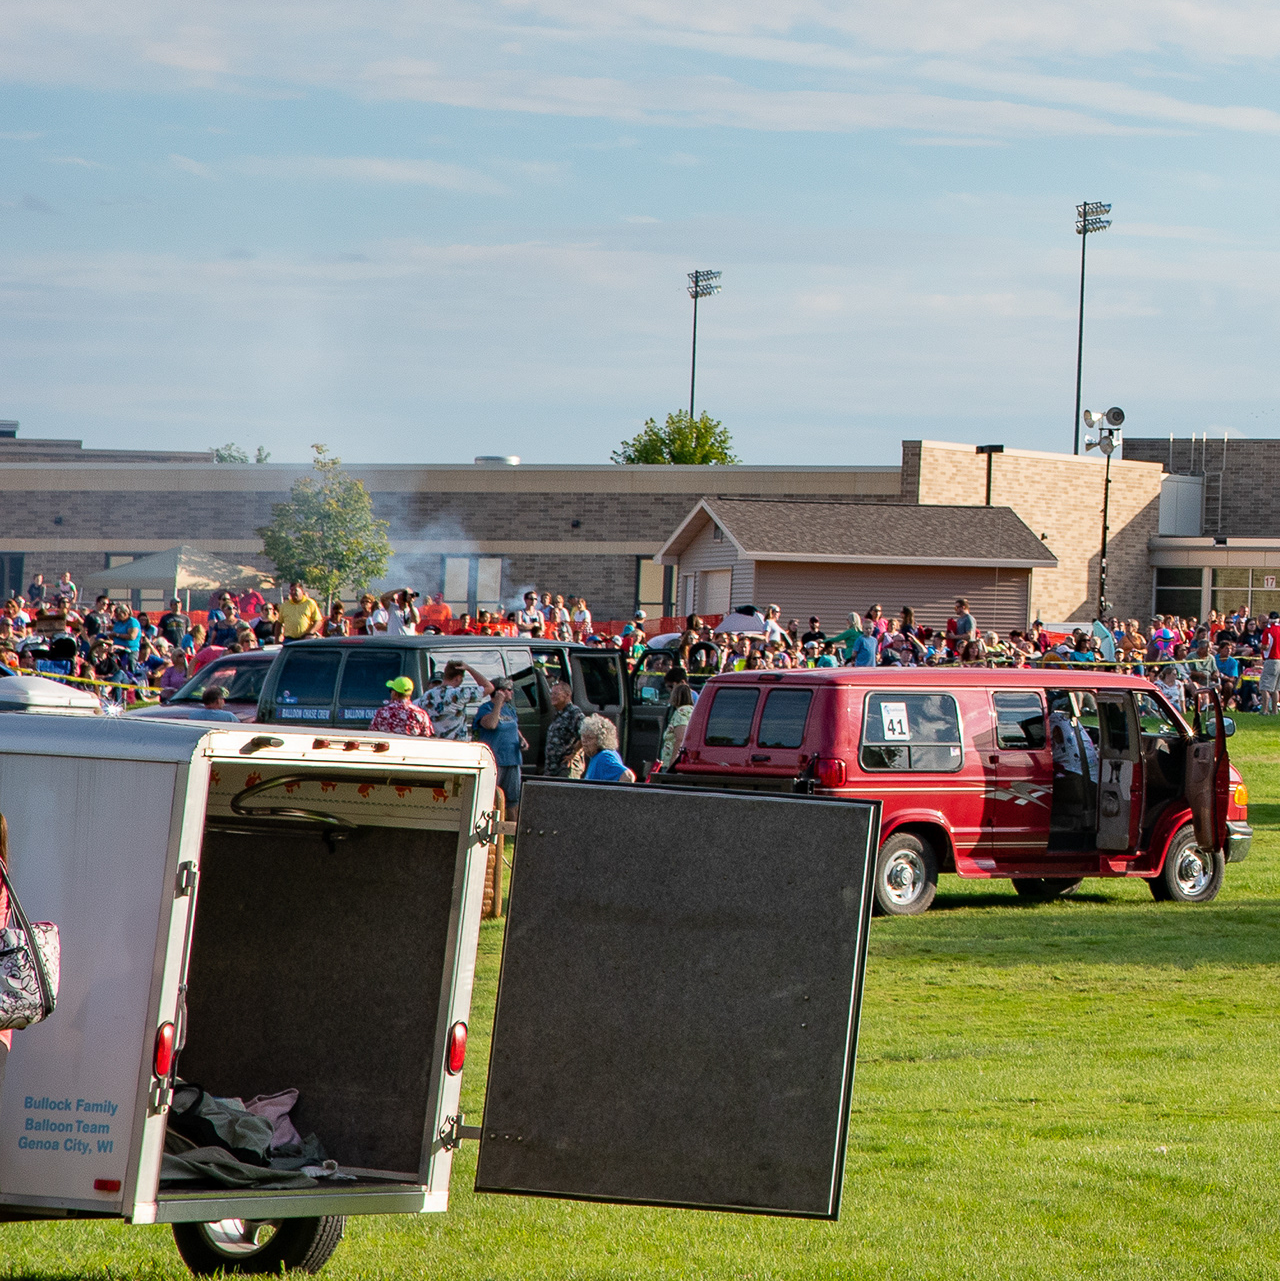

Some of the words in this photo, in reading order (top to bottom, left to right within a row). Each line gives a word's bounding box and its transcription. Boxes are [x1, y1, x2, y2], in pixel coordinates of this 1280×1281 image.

[1265, 577, 1275, 587] 17
[282, 708, 302, 719] BALLOON
[302, 709, 317, 719] CHASE
[317, 709, 330, 719] CREW
[344, 709, 365, 719] BALLOON
[887, 718, 906, 735] 41
[24, 1096, 72, 1111] Bullock
[76, 1098, 119, 1117] Family
[25, 1118, 73, 1133] Balloon
[75, 1119, 110, 1134] Team
[18, 1136, 59, 1150] Genoa
[64, 1138, 93, 1155] City,
[97, 1140, 114, 1153] WI
